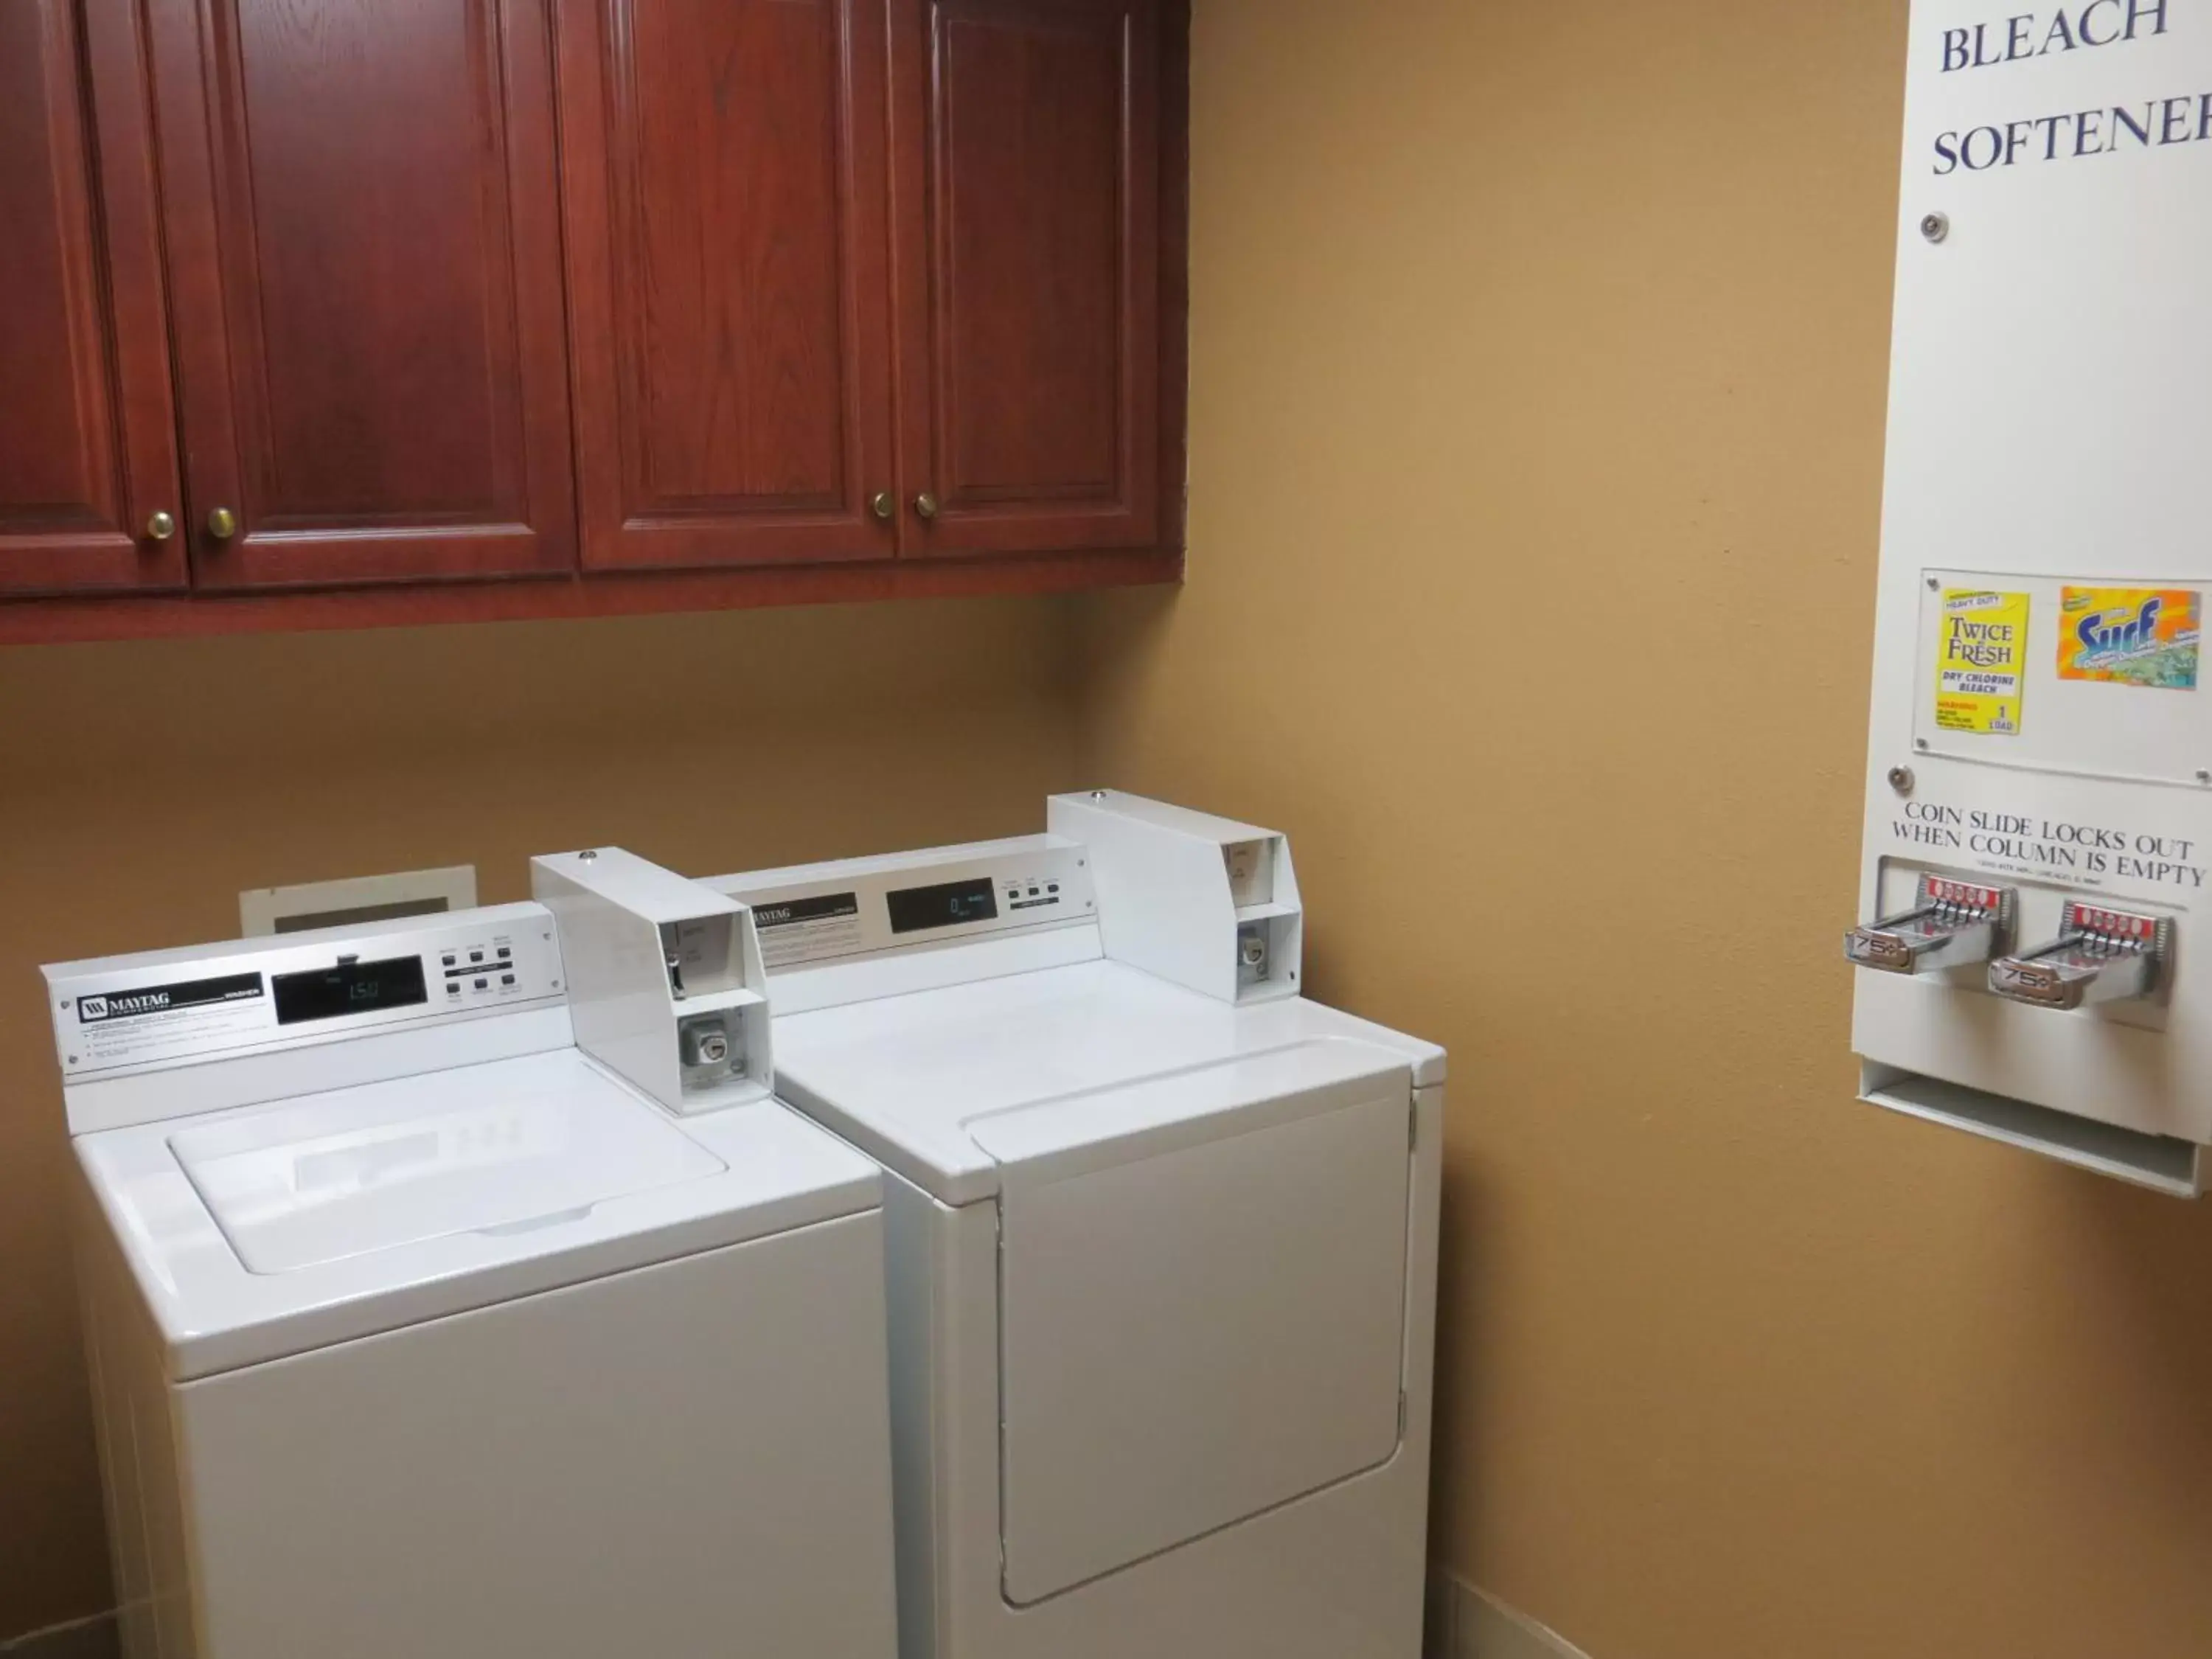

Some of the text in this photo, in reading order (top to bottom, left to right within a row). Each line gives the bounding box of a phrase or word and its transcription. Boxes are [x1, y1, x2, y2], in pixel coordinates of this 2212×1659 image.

[1941, 0, 2167, 72] BLEACH
[2074, 598, 2161, 667] Surf
[1943, 671, 2015, 686] DRY CHLORINE
[1958, 683, 1997, 693] BLEACH
[1998, 705, 2006, 718] 1
[1989, 720, 2014, 731] LOAD
[1905, 801, 2194, 860] COIN SLIDE LOCKS OUT
[1893, 820, 1961, 849] WHEN
[1969, 834, 2076, 867] COLUMN
[2087, 852, 2107, 873] IS
[2117, 855, 2208, 887] EMPTY
[109, 992, 170, 1011] MAYTAG
